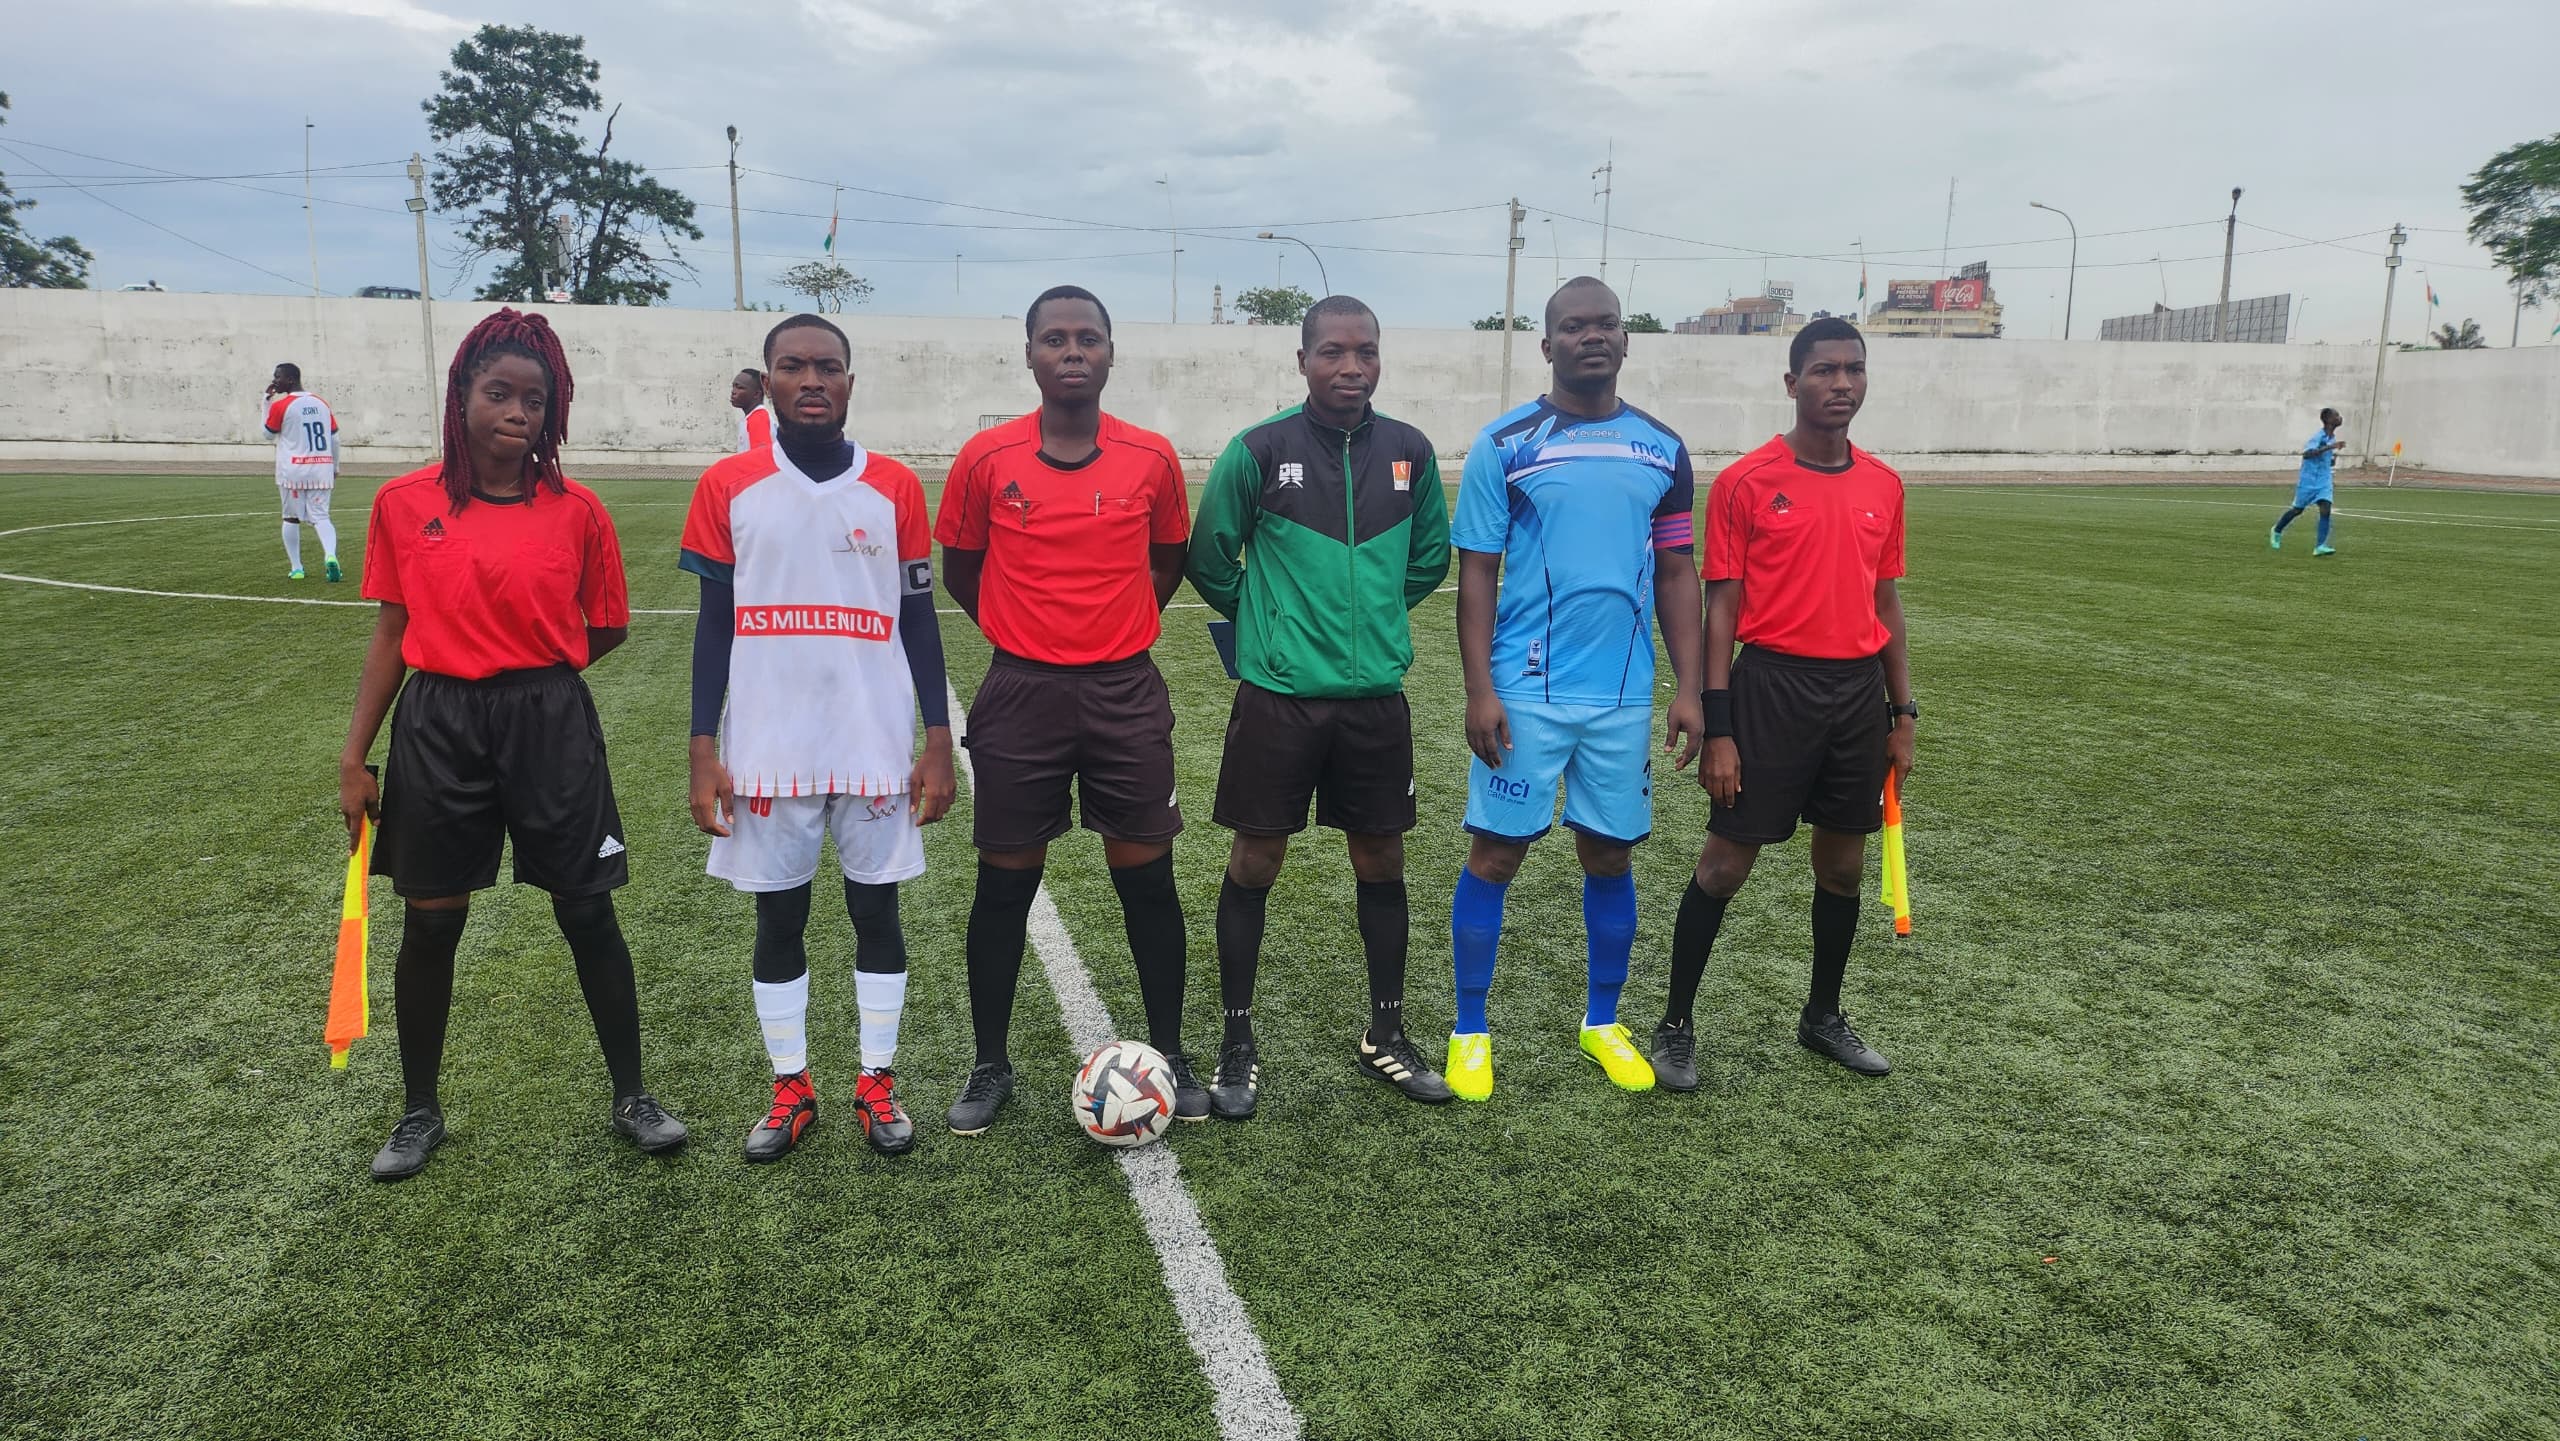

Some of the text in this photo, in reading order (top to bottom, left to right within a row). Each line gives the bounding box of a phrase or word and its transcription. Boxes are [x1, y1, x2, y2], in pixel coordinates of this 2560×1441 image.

[303, 421, 327, 452] 18
[907, 562, 931, 590] C
[741, 611, 768, 630] AS
[1489, 775, 1530, 798] mci
[597, 844, 625, 858] adidas
[1380, 1000, 1403, 1009] KIP
